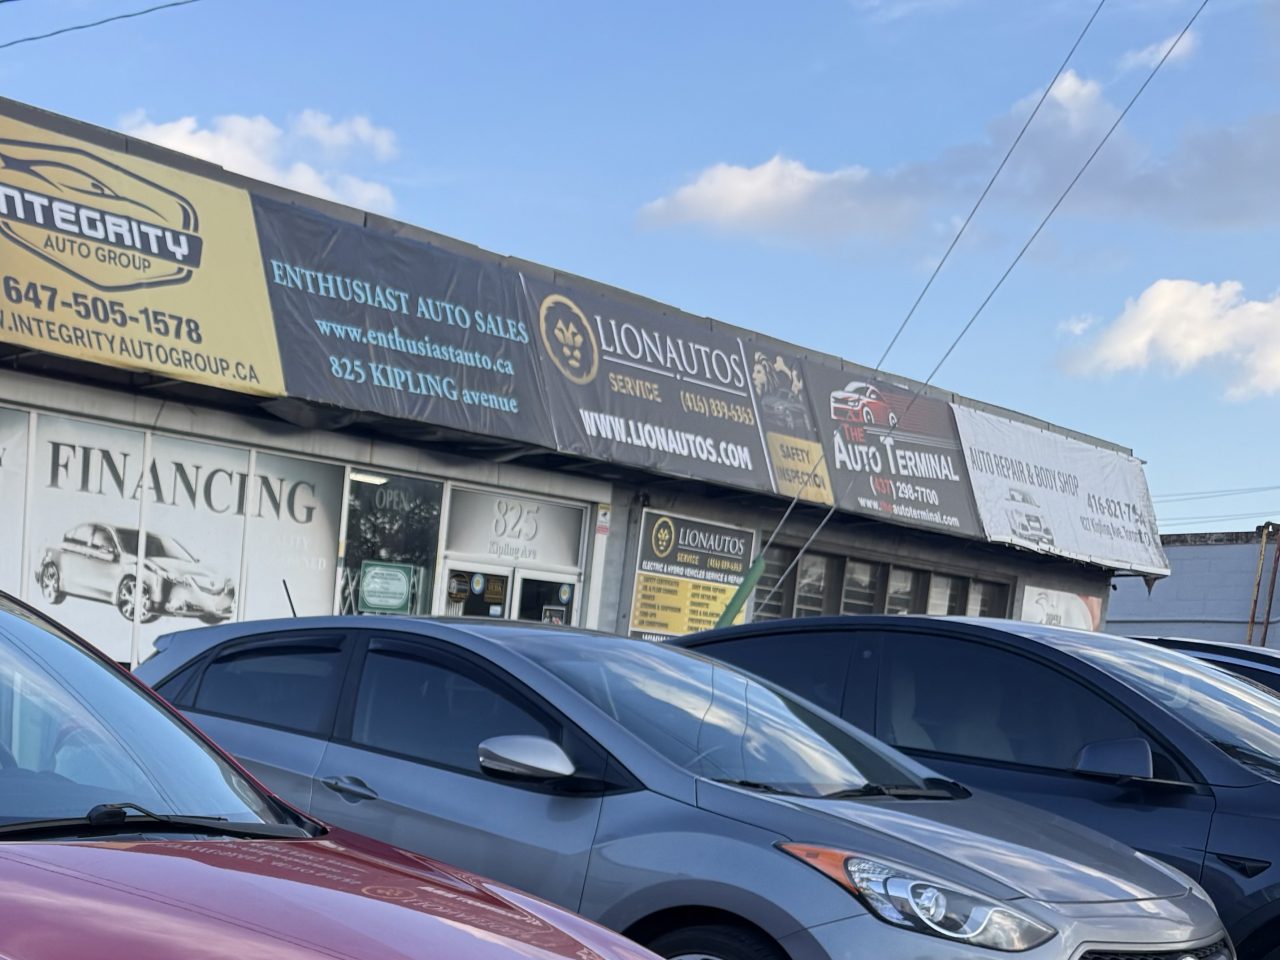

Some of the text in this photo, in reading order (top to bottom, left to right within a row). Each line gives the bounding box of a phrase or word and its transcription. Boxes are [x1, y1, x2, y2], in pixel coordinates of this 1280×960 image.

[43, 234, 151, 273] AUTO GROUP
[3, 275, 202, 344] 647-505-1578
[270, 260, 529, 344] ENTHUSIAST AUTO SALES
[315, 319, 514, 375] www.enthusiastauto.ca
[595, 315, 745, 388] LIONAUTOS
[329, 356, 518, 413] 825 KIPLING avenue
[609, 372, 662, 402] SERVICE
[680, 390, 707, 416] (416)
[579, 408, 753, 470] WWW.LIONAUTOS.COM
[779, 444, 811, 464] SAFETY
[833, 430, 960, 481] AUTO TERMINAL
[843, 423, 865, 442] THE
[47, 440, 317, 525] FINANCING
[870, 475, 939, 506] (437) 298-7700
[969, 447, 1079, 497] AUTO REPAIR & BODY SHOP
[494, 500, 540, 541] 825
[678, 528, 745, 555] LIONAUTOS
[642, 560, 663, 572] ELECTRIC
[667, 564, 684, 576] HYBRID
[684, 566, 705, 578] VEHICLES
